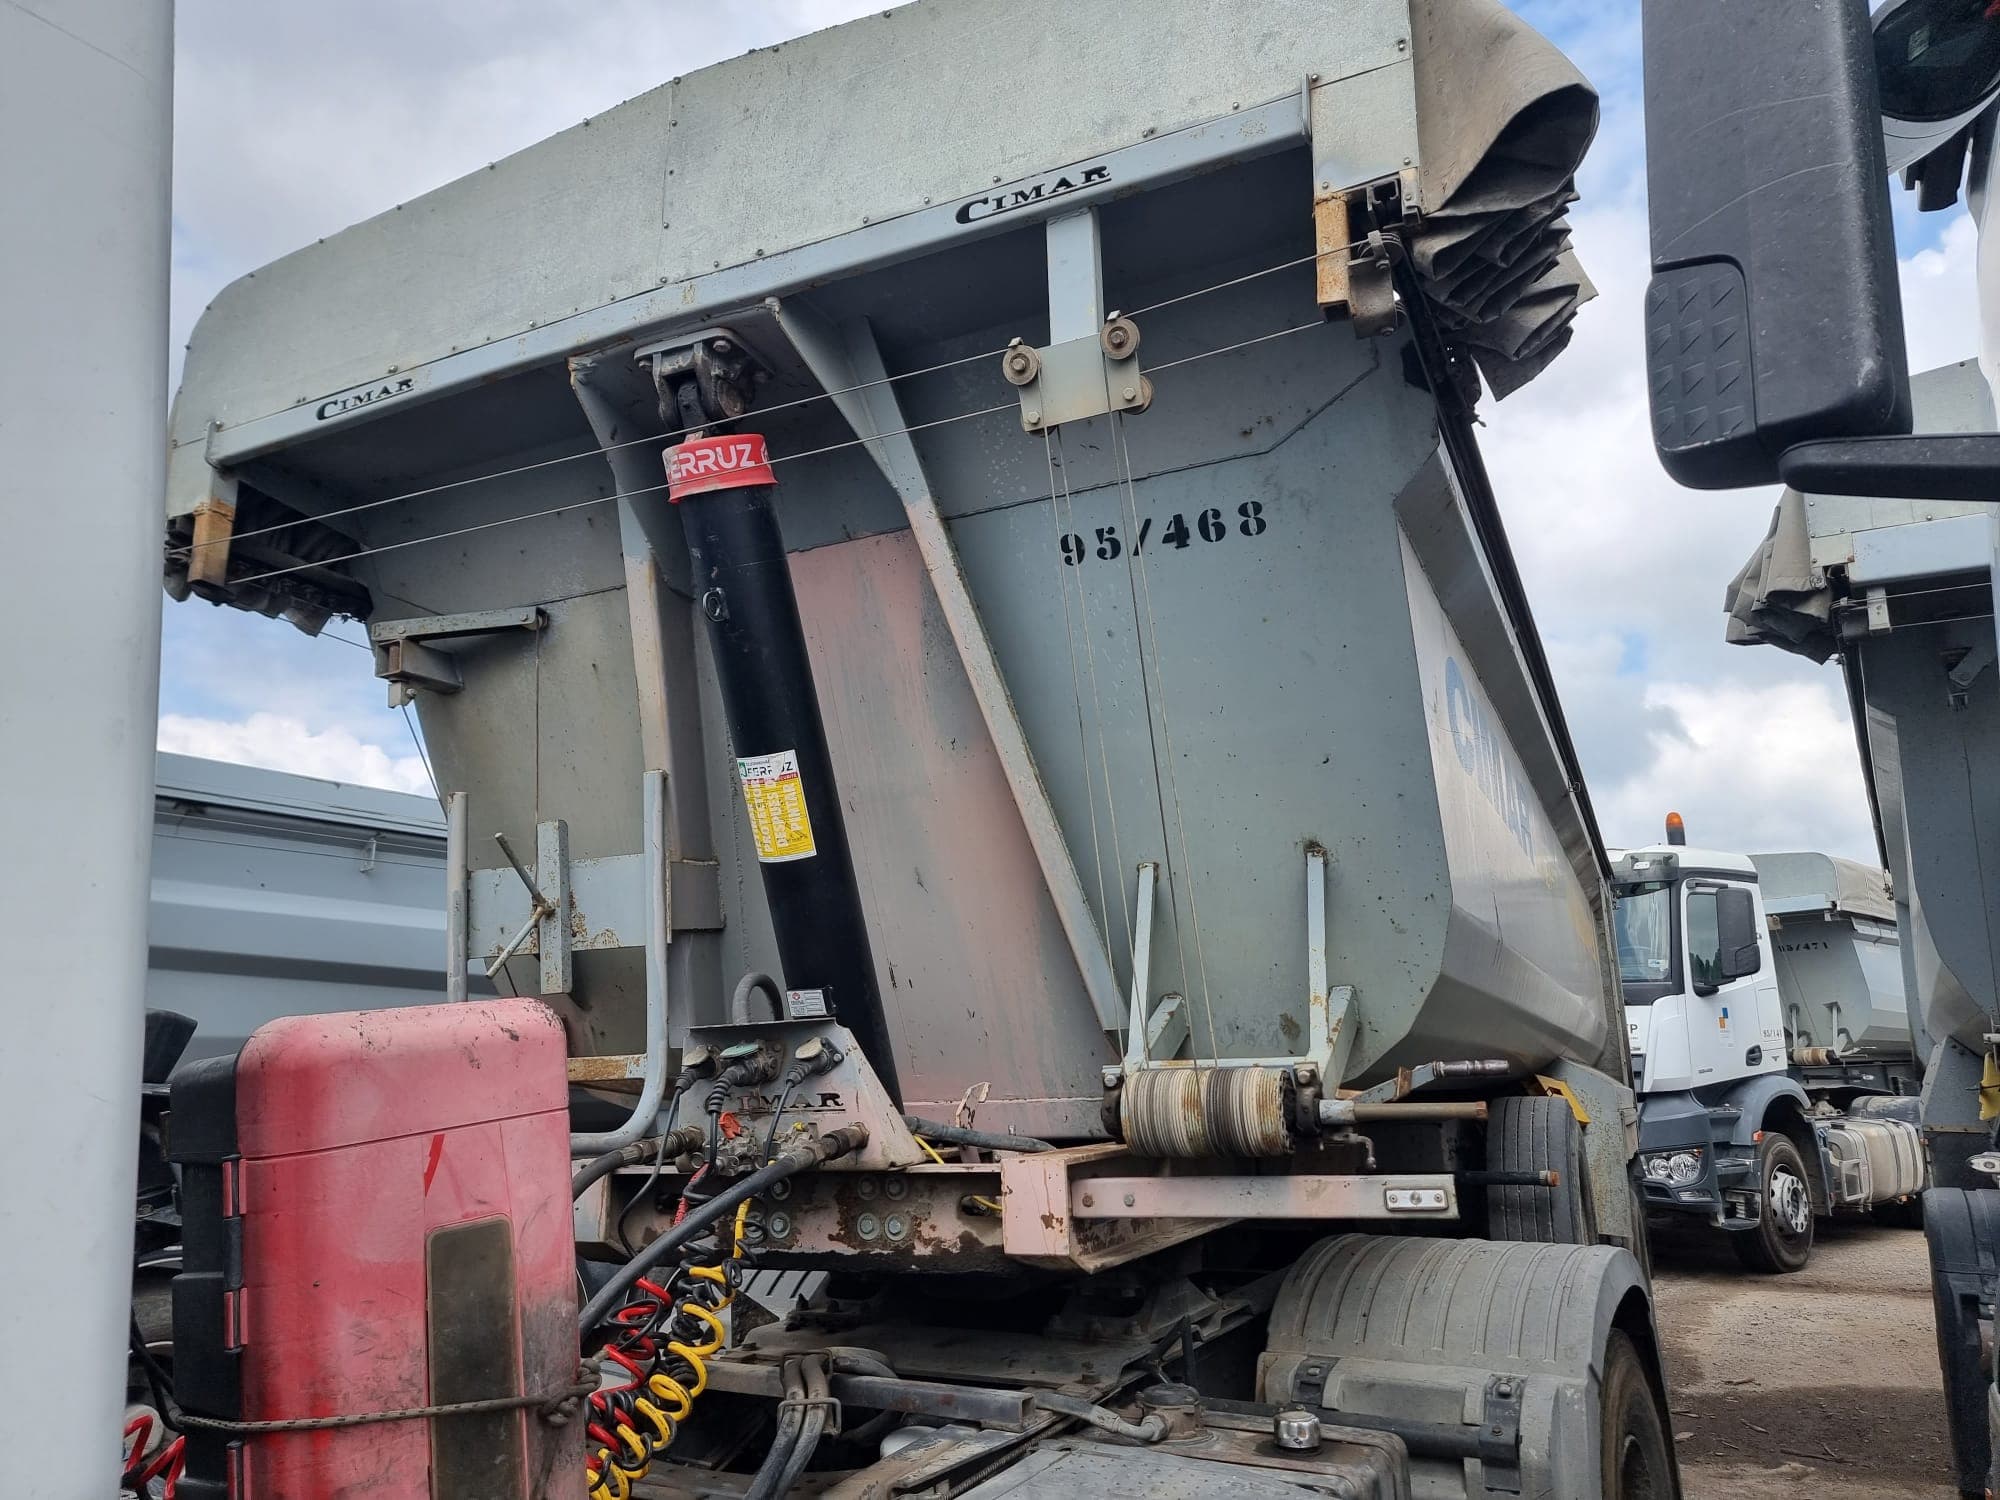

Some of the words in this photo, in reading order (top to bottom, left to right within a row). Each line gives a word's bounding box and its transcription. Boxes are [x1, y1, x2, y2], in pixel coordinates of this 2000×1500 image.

[956, 165, 1112, 224] CIMAR
[316, 378, 414, 420] CIMAR
[669, 443, 755, 479] ERRUZ
[1060, 501, 1267, 566] 95/468
[737, 1092, 845, 1112] IMAR
